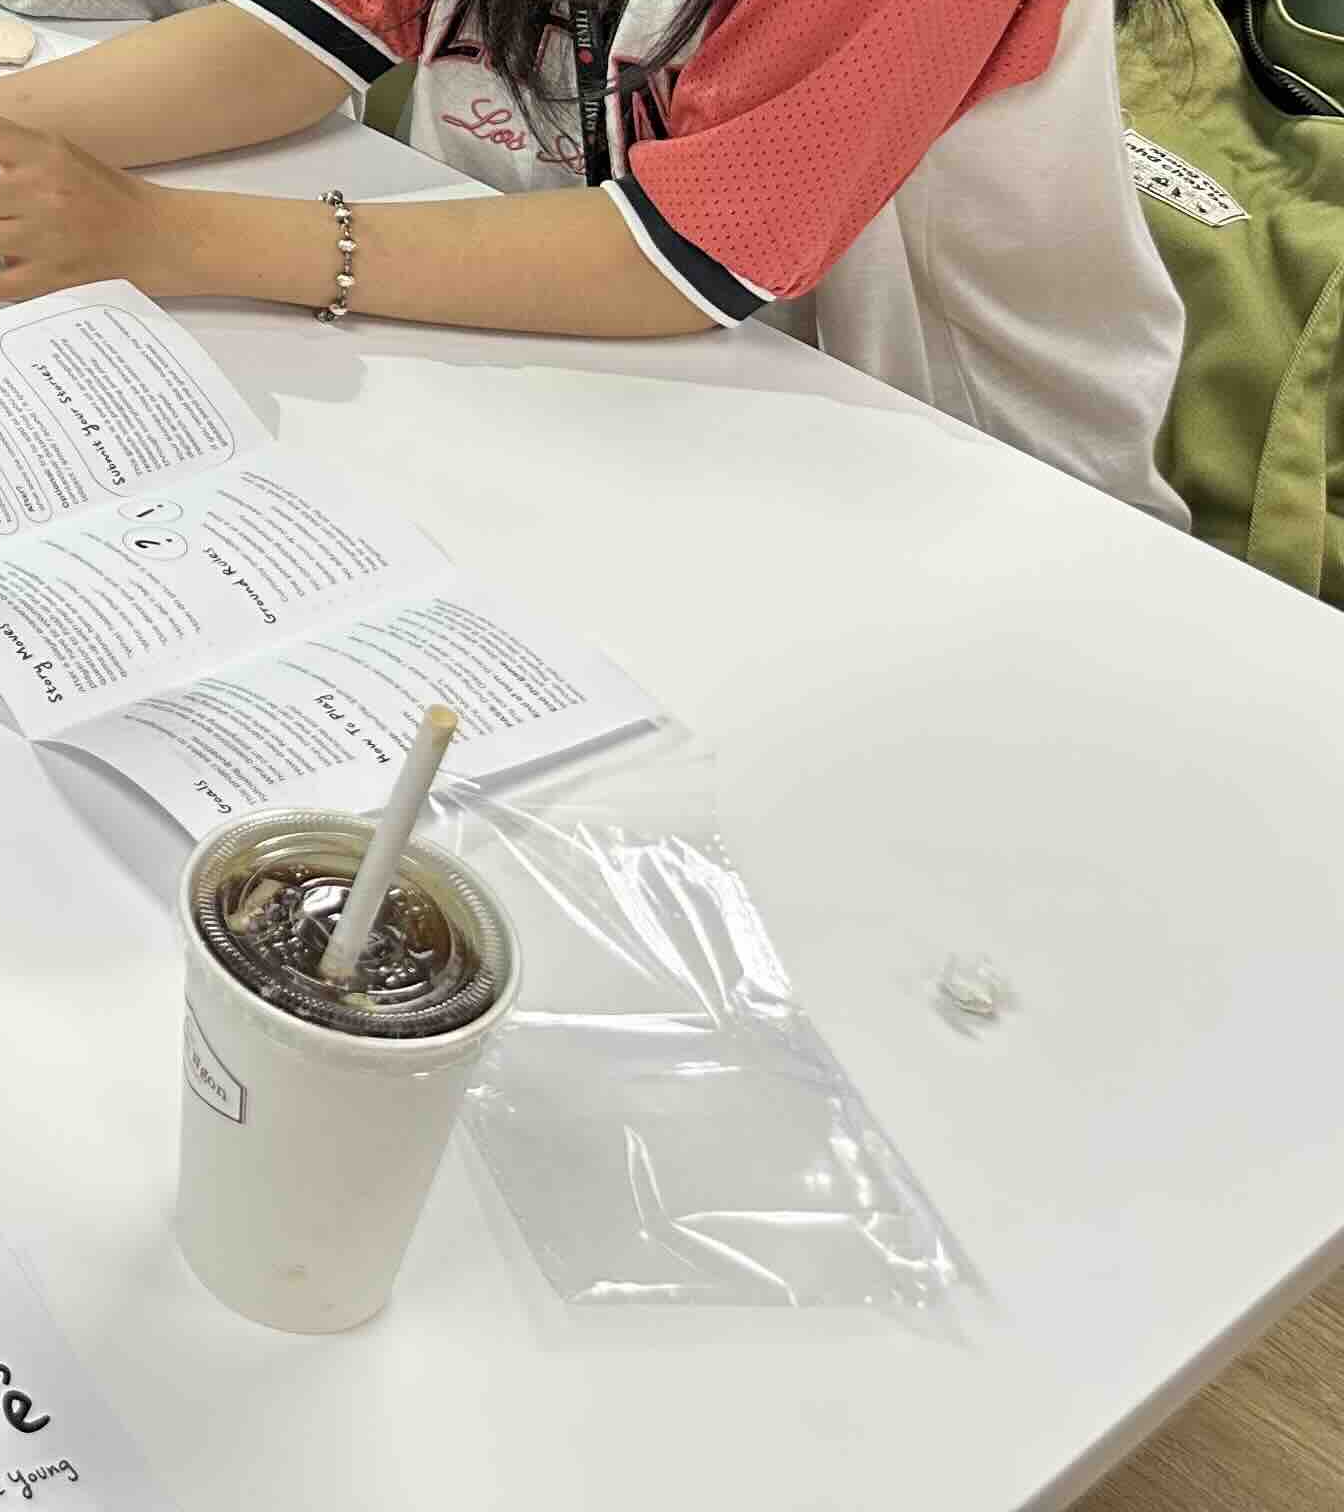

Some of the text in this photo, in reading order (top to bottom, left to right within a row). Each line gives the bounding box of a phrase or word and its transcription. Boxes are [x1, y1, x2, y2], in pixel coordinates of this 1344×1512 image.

[442, 99, 527, 150] Los
[31, 363, 126, 486] Submit Your Stories!
[13, 485, 36, 516] After?
[43, 468, 70, 509] Optional:
[202, 547, 277, 625] Ground Rules
[32, 660, 64, 704] Story
[313, 694, 391, 764] How To Play
[193, 779, 233, 814] Goals
[7, 1458, 80, 1500] Young
